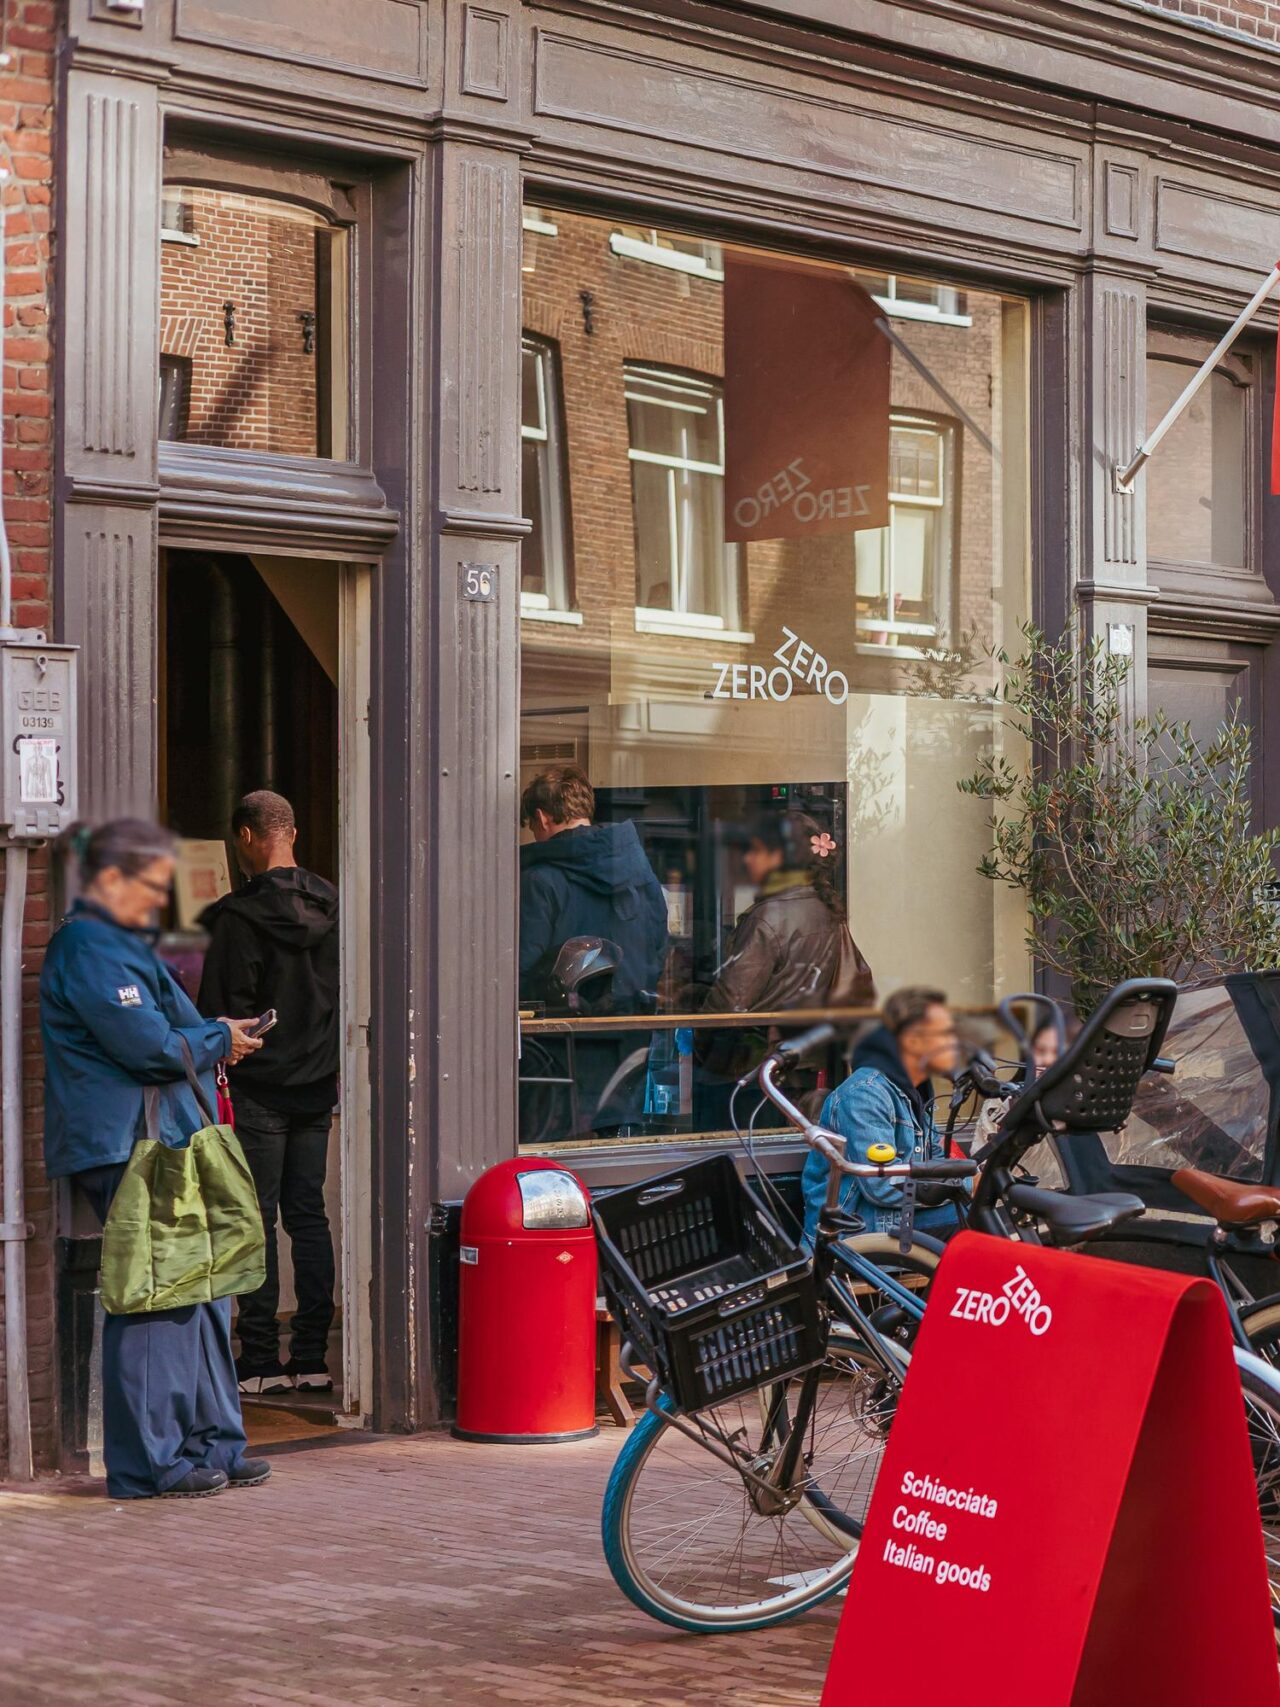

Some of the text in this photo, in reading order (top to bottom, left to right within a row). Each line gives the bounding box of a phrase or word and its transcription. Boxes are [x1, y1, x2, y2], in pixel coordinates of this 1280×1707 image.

[467, 569, 490, 595] 56
[712, 662, 793, 702] ZERO
[773, 625, 849, 705] ZERO
[22, 717, 54, 728] 03139
[949, 1287, 1011, 1326] ZERO
[1002, 1264, 1053, 1336] ZERO
[901, 1471, 998, 1518] Schiacciata
[892, 1505, 948, 1541] Coffee
[882, 1538, 991, 1592] Italian goods
